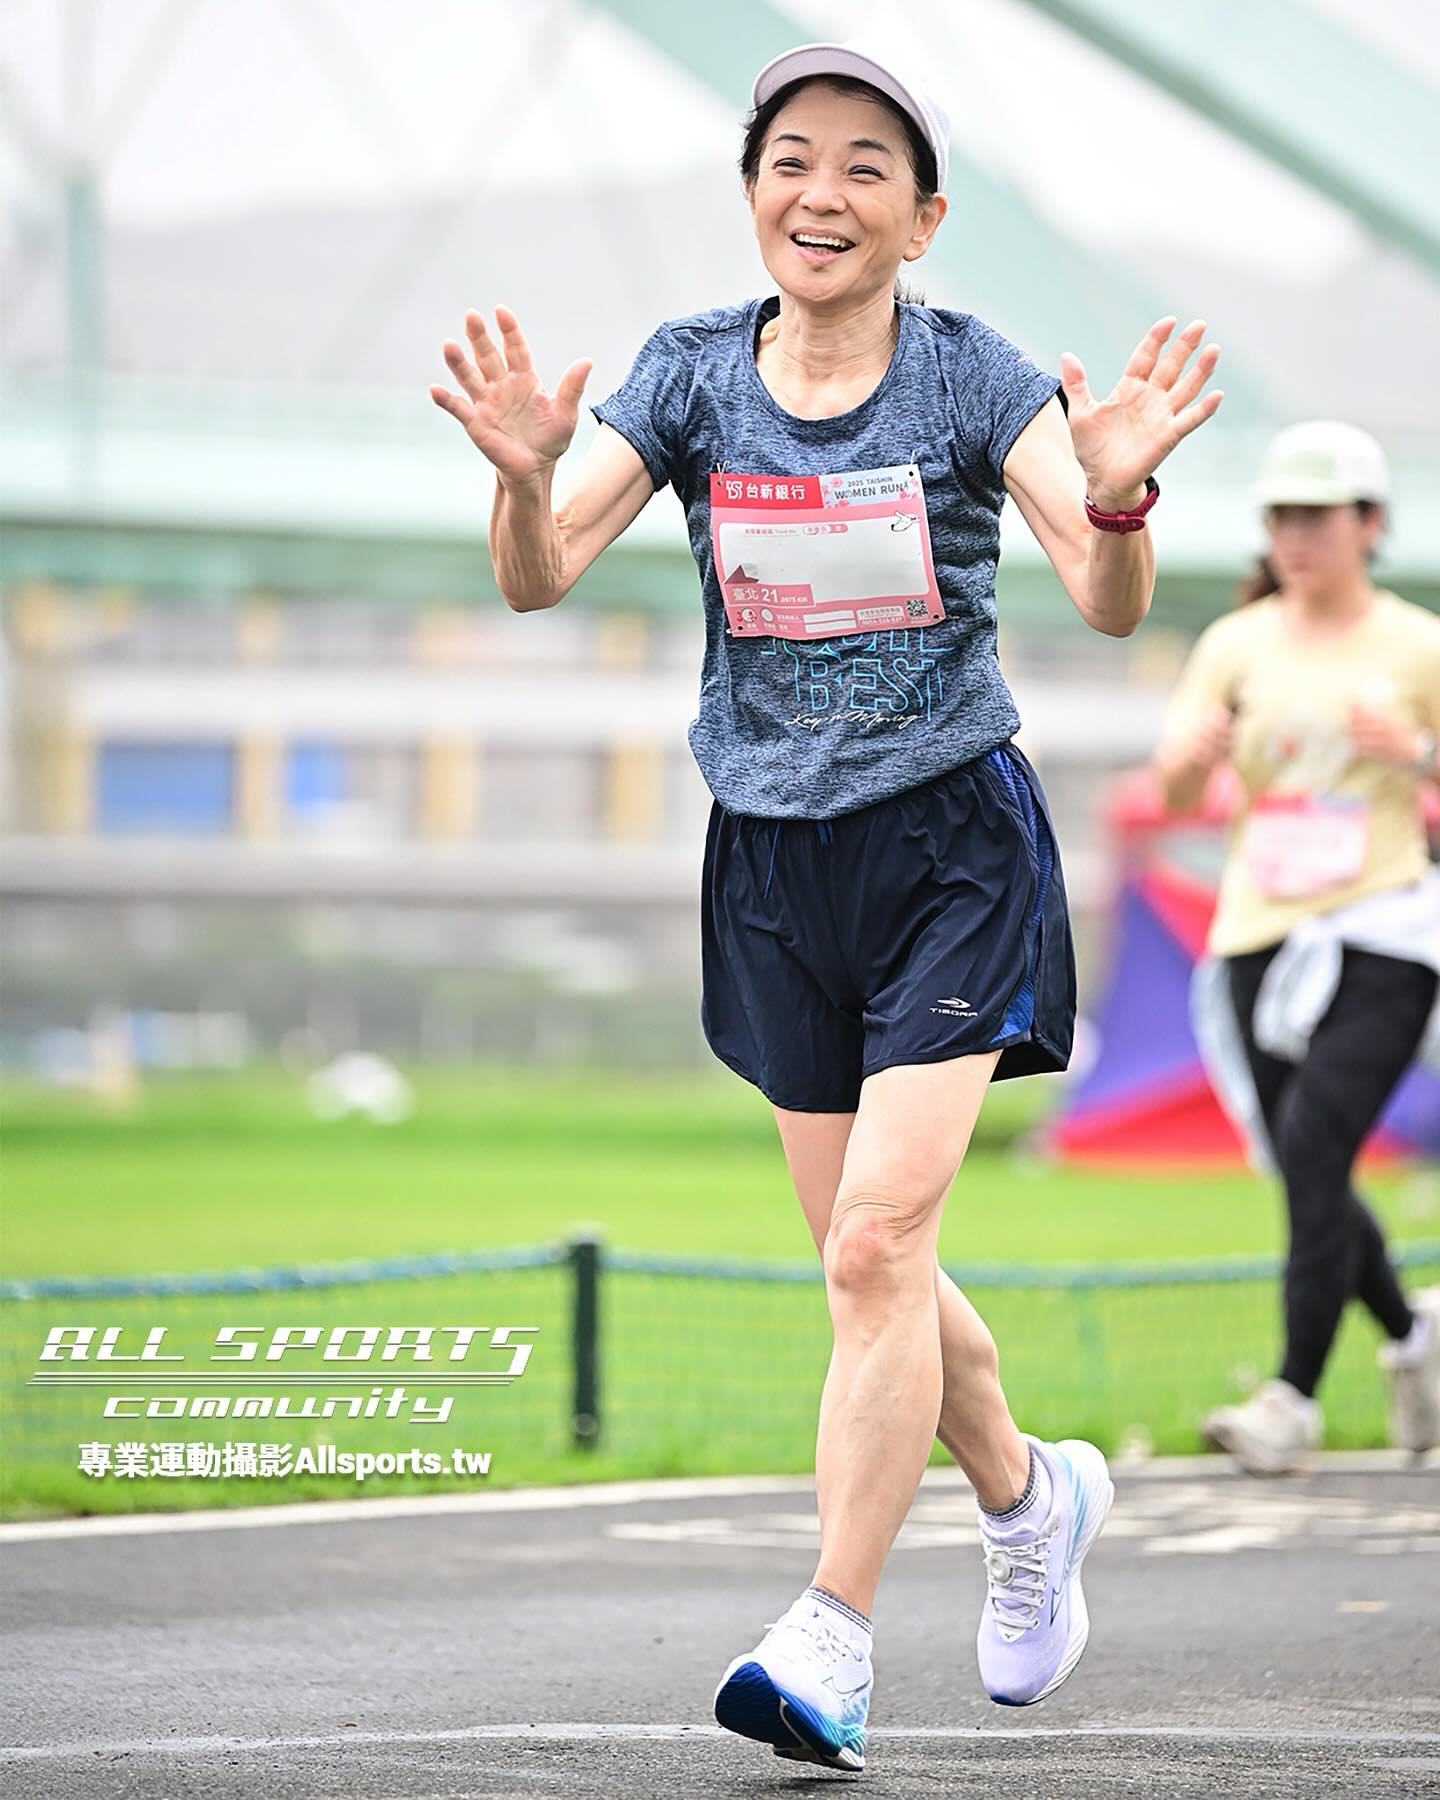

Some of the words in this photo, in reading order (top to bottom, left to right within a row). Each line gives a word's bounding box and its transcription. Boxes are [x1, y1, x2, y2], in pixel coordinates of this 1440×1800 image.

[866, 476, 894, 485] TAISHIN
[746, 482, 806, 500] 台新銀行
[834, 486, 877, 500] WOMEN
[880, 483, 904, 495] RUN
[794, 656, 943, 721] BEST
